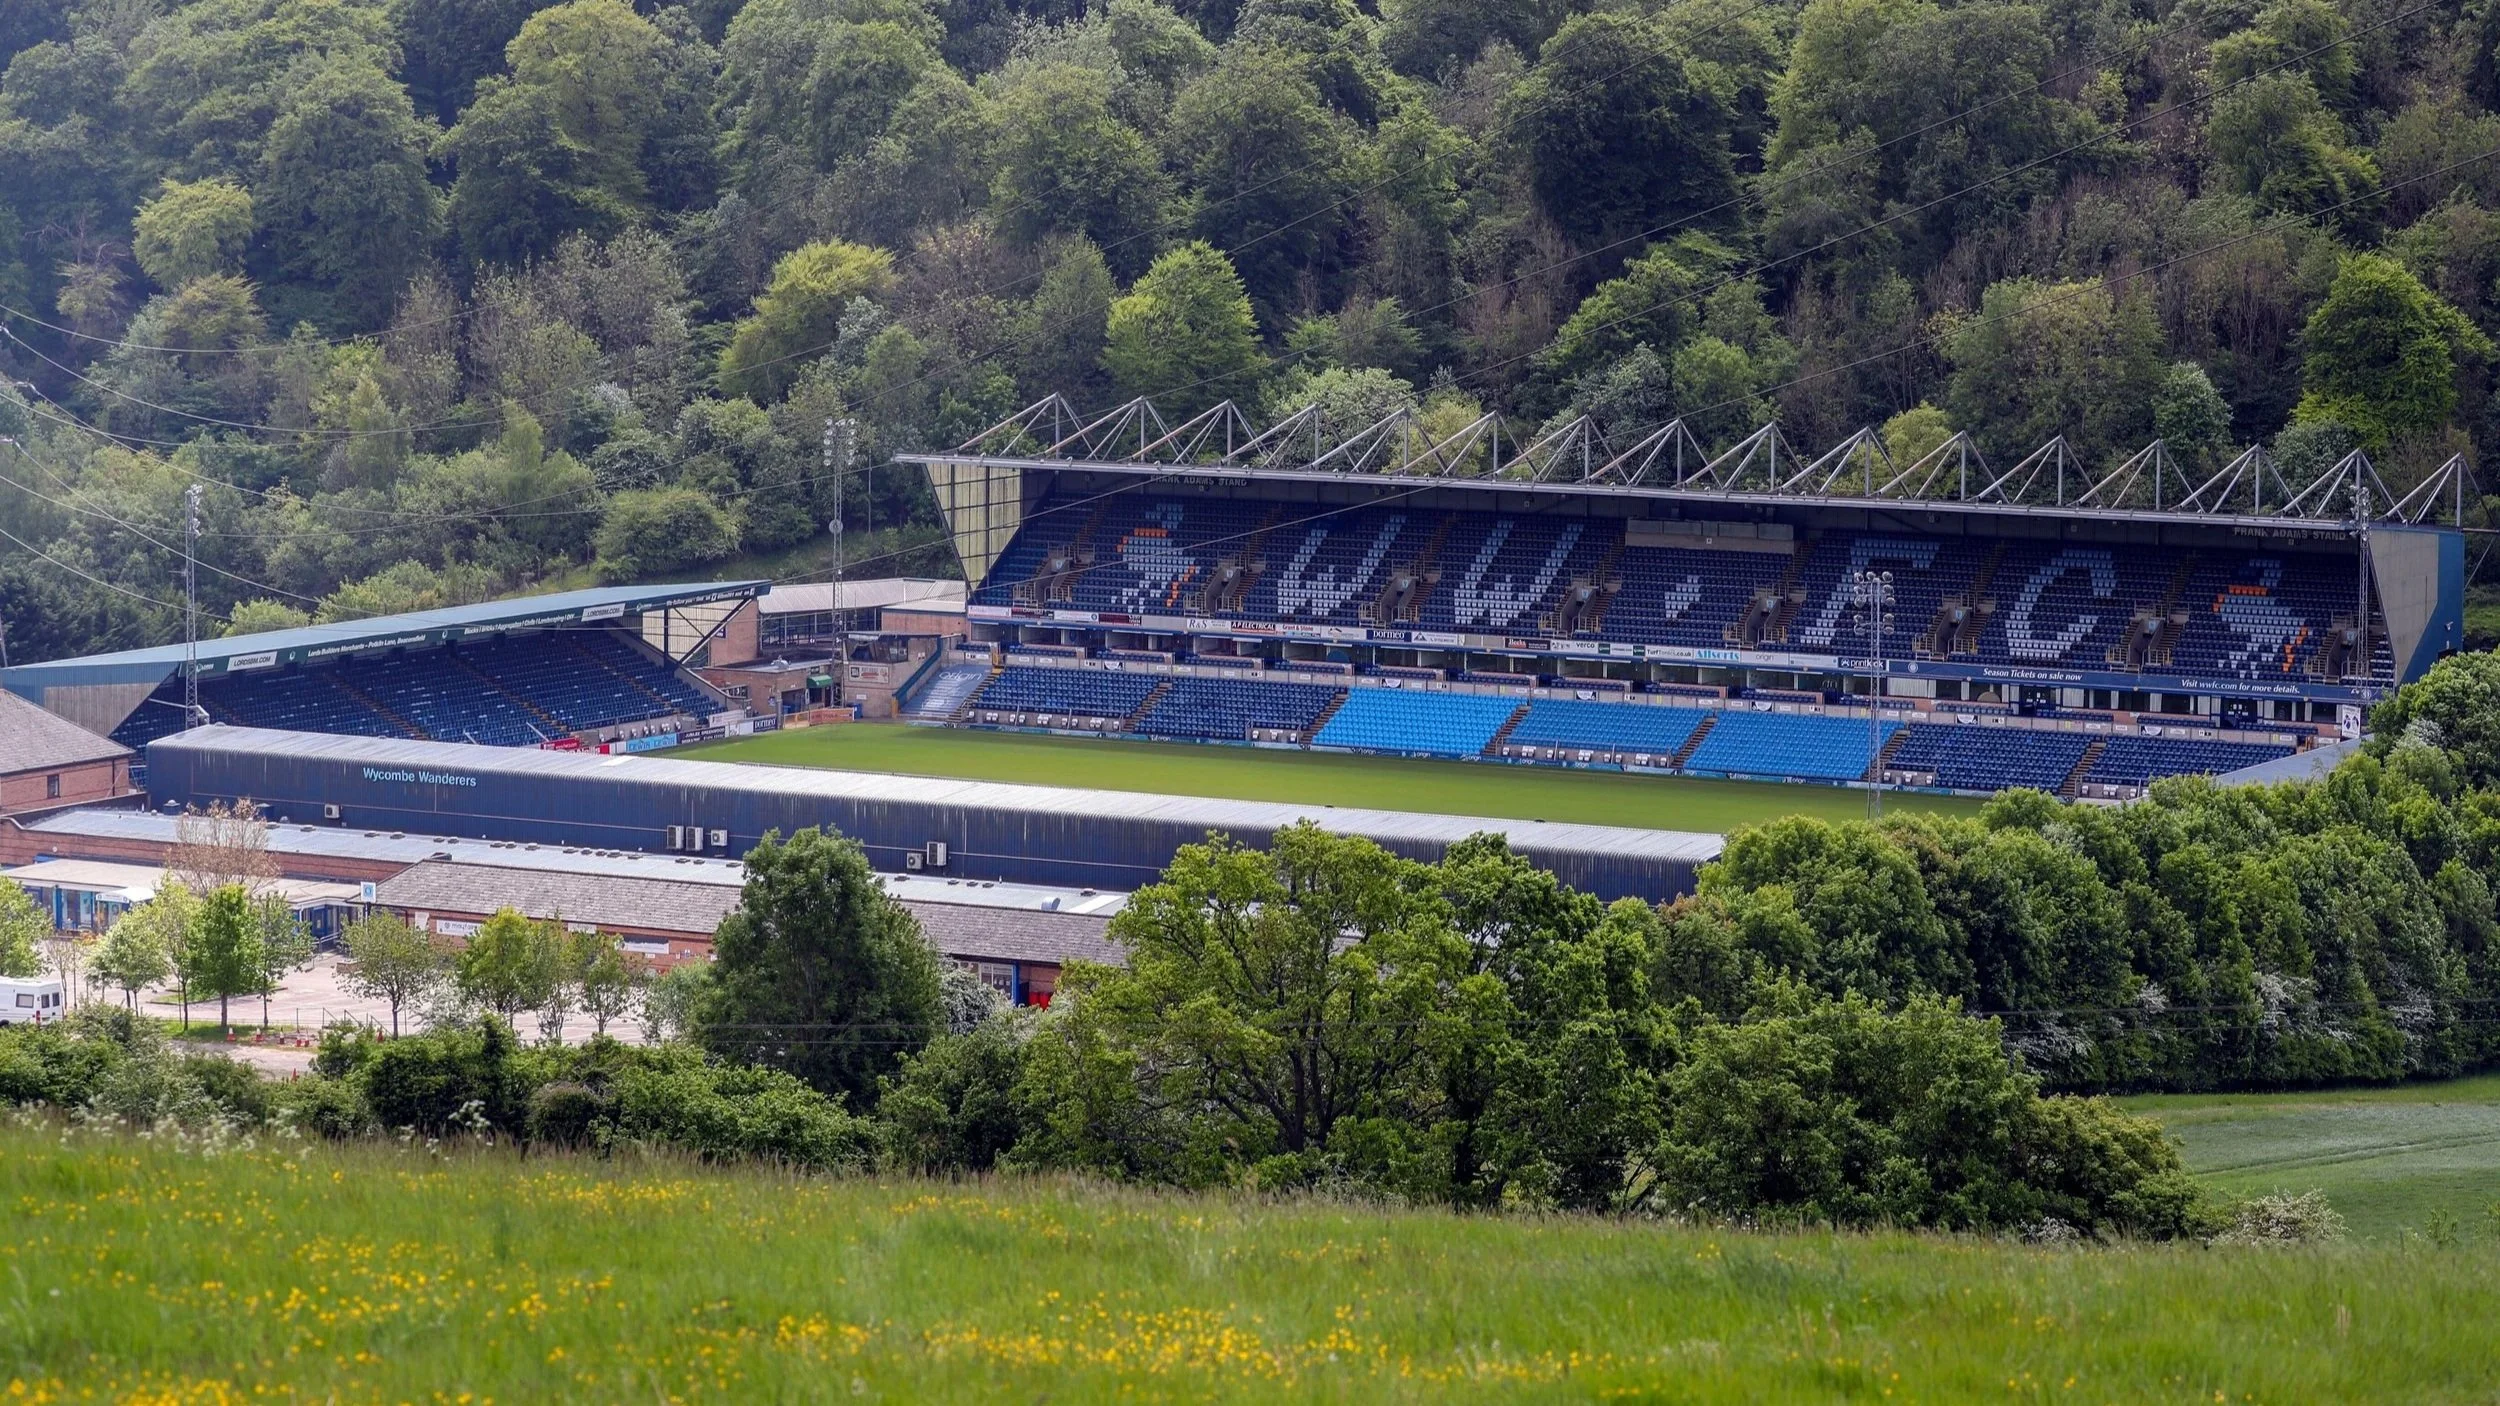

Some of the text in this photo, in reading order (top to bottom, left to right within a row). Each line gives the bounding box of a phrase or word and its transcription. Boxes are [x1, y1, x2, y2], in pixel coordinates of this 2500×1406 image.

[2234, 527, 2346, 541] FRANK ADAMS STAND
[1850, 659, 1884, 668] printkck
[1983, 668, 2009, 678] Season
[2010, 669, 2036, 679] Tickets
[2049, 671, 2064, 680] sale
[2065, 673, 2083, 681] now
[2181, 679, 2300, 694] Visit wwfc.com for more details.
[363, 767, 477, 787] Wycombe Wanderers
